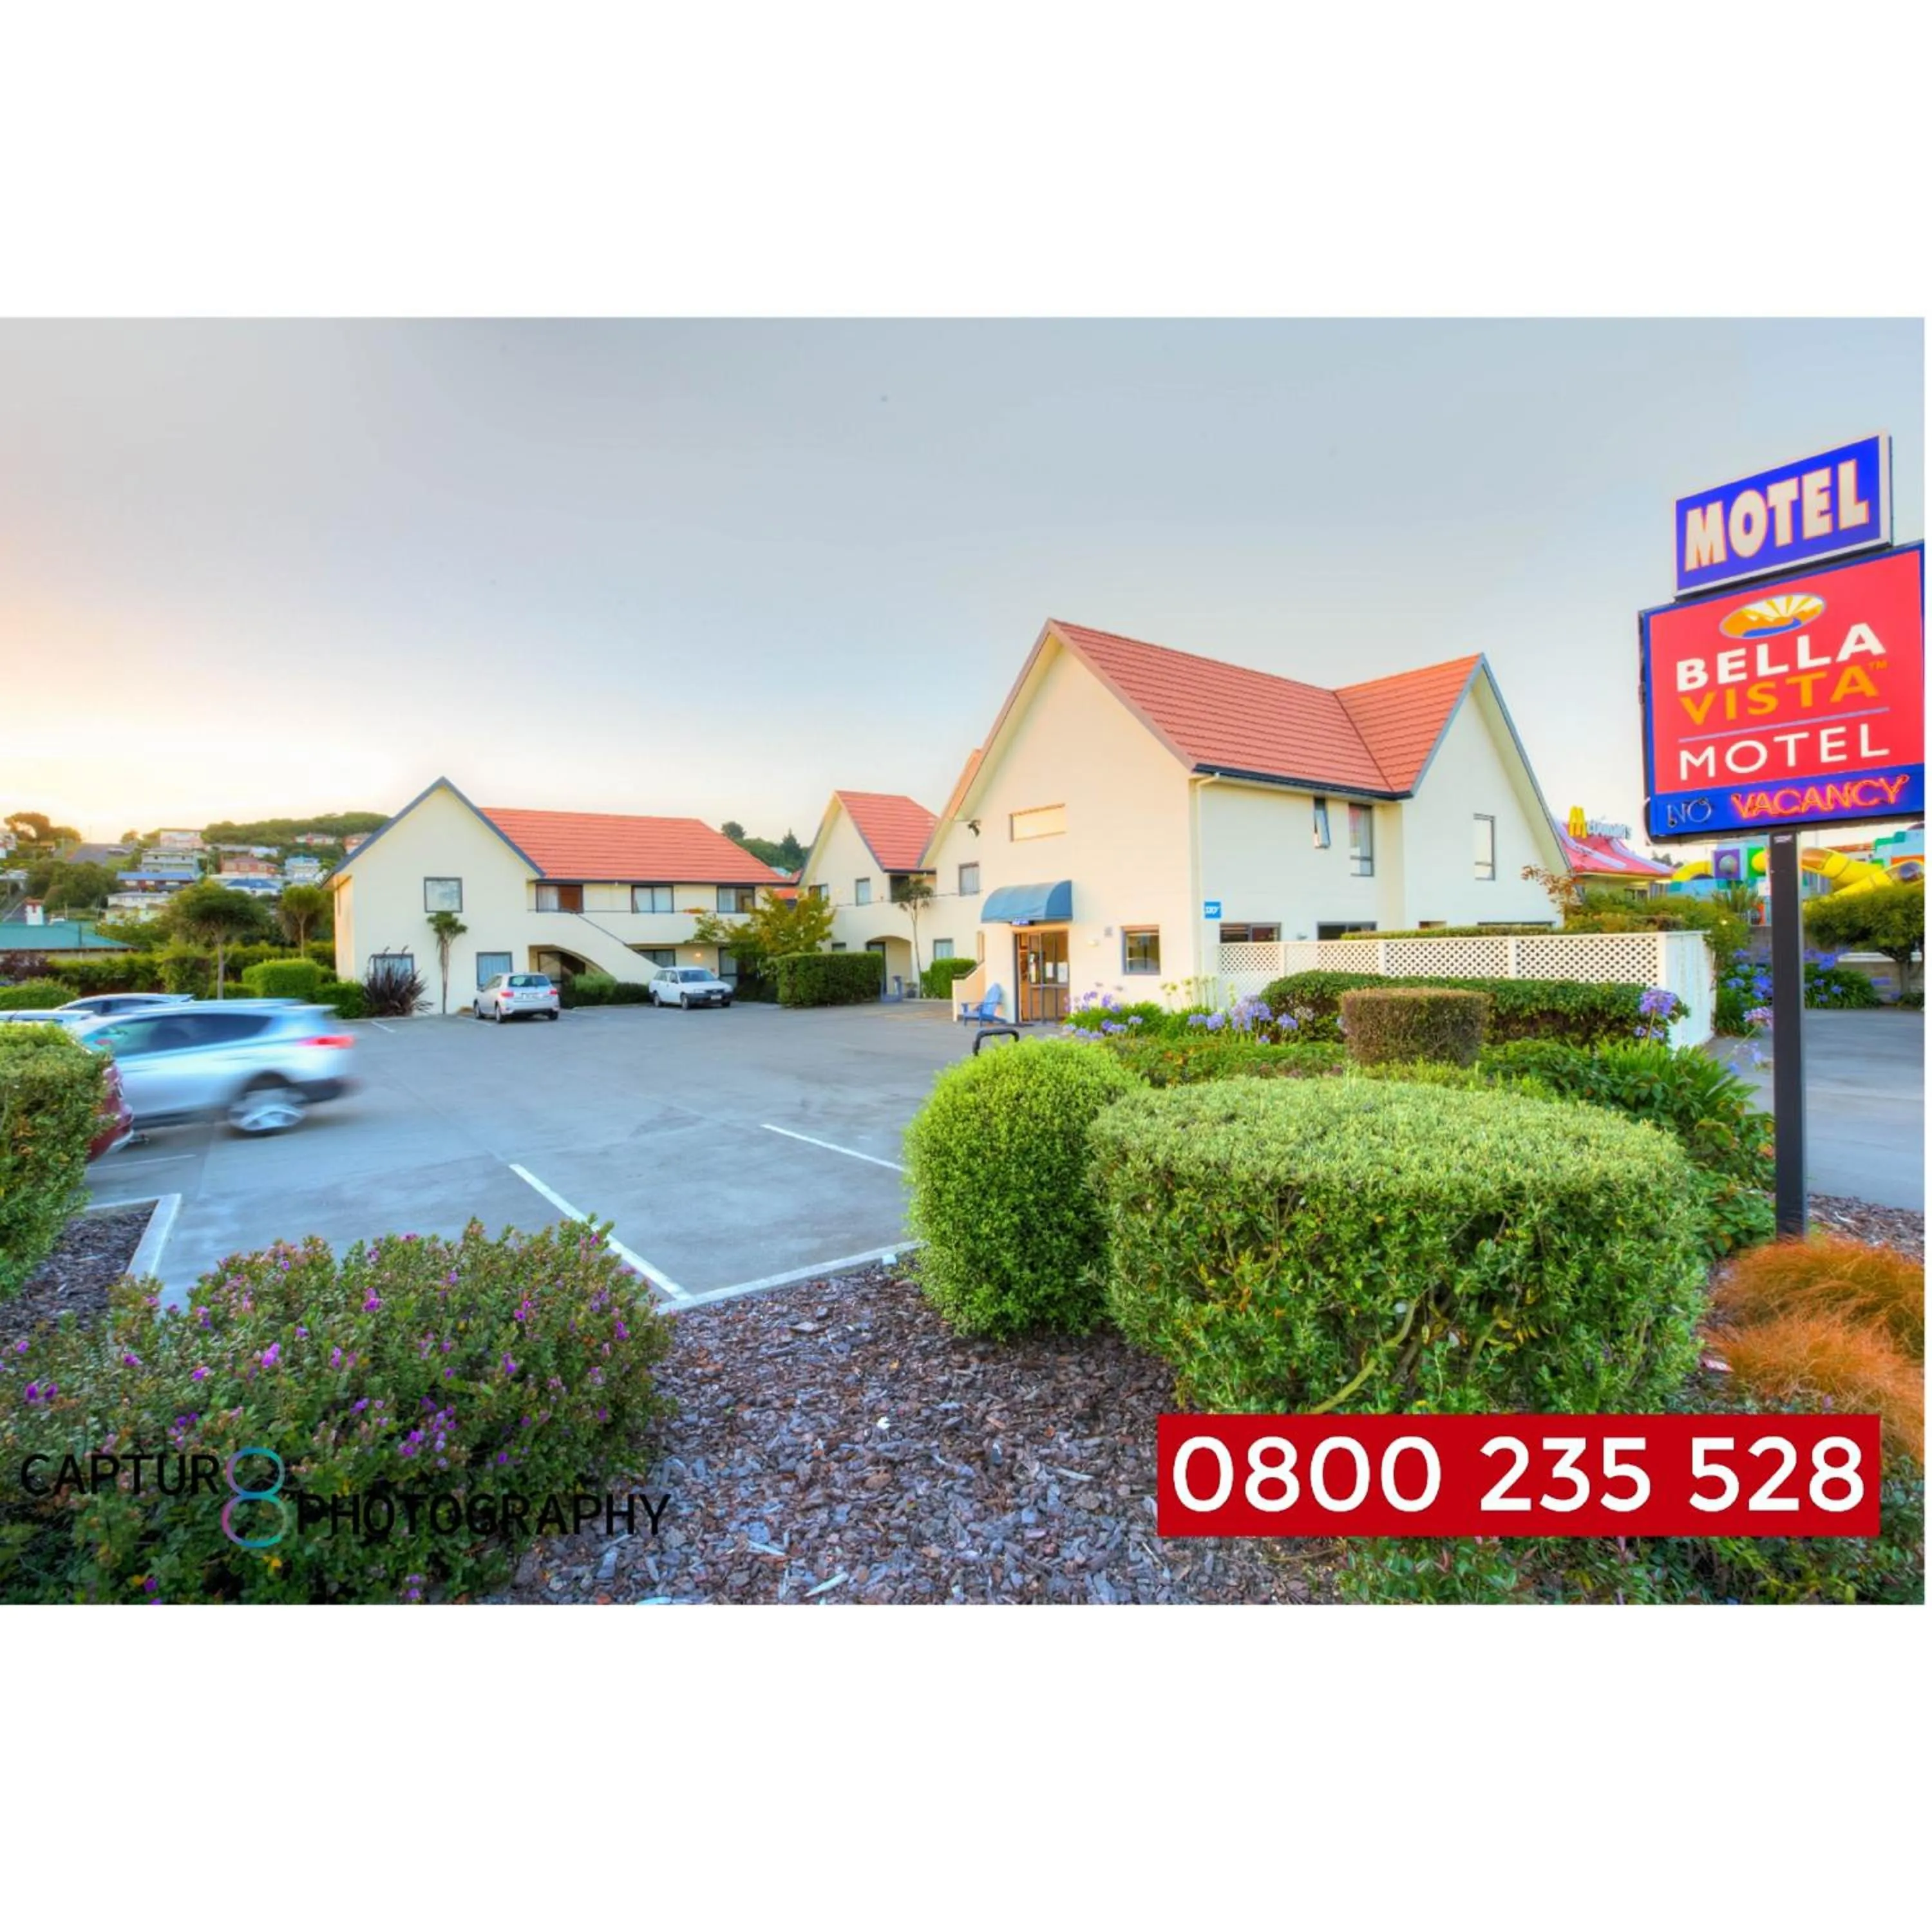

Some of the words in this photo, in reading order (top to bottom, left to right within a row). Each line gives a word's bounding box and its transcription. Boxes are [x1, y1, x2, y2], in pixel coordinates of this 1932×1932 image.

[1684, 459, 1870, 573] MOTEL
[1676, 622, 1886, 692] BELLA
[1679, 665, 1879, 725] VISTA
[1679, 722, 1890, 781] MOTEL
[1667, 797, 1712, 827] NO
[1732, 774, 1910, 819] VACANCY
